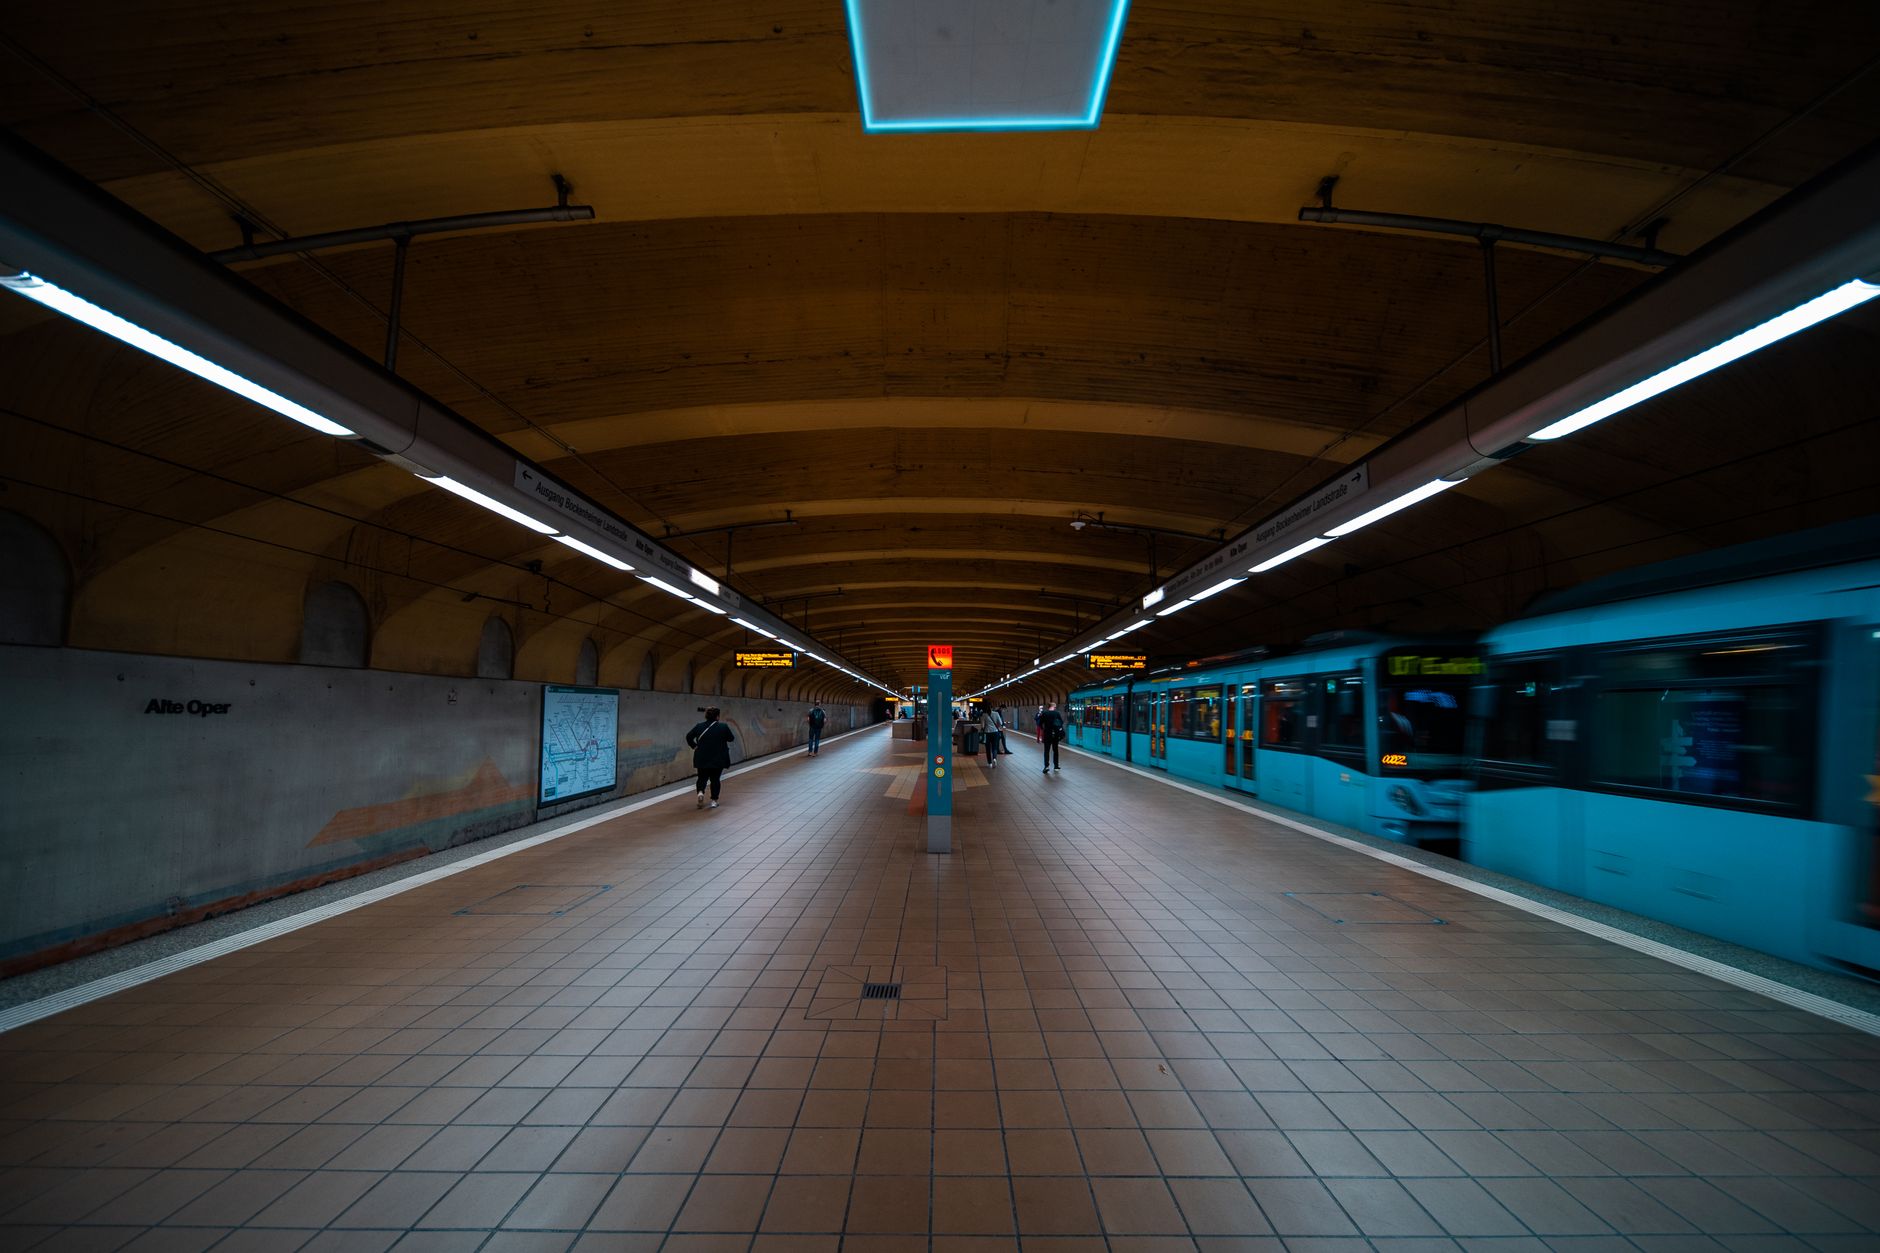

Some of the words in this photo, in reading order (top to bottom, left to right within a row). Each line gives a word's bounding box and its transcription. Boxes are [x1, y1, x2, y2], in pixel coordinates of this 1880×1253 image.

[535, 481, 564, 509] Ausgang
[1312, 483, 1348, 511] Landstraße
[144, 699, 184, 714] Alte
[187, 700, 232, 718] Oper
